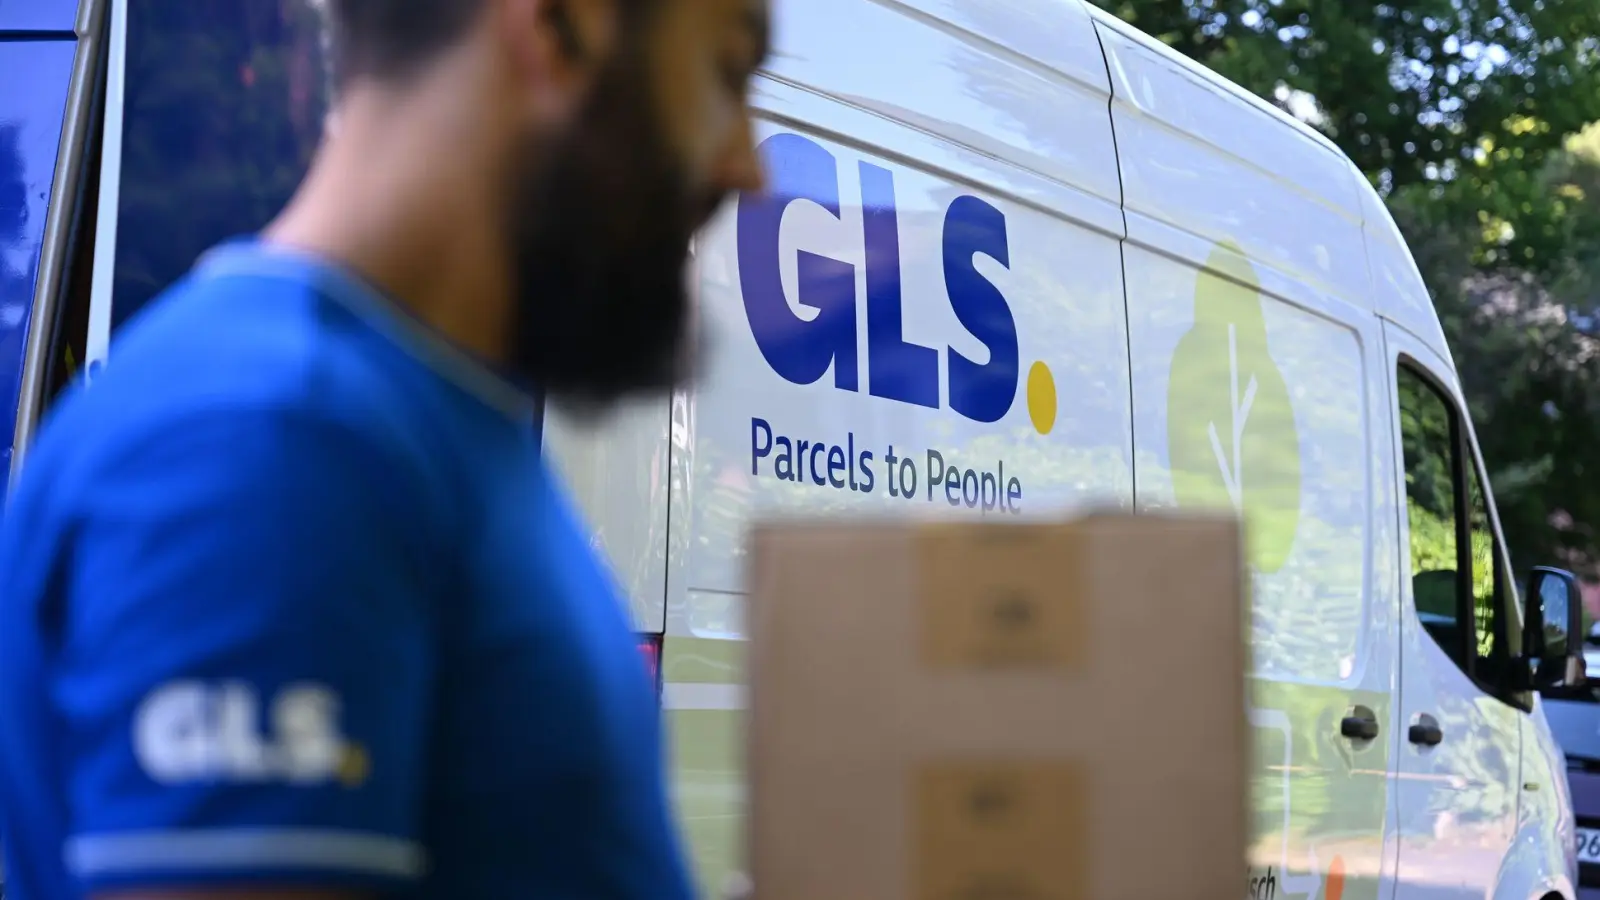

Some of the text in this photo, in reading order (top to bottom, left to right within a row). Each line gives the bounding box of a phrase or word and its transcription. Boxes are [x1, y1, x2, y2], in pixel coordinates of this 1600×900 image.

[751, 417, 1022, 515] Parcels to People
